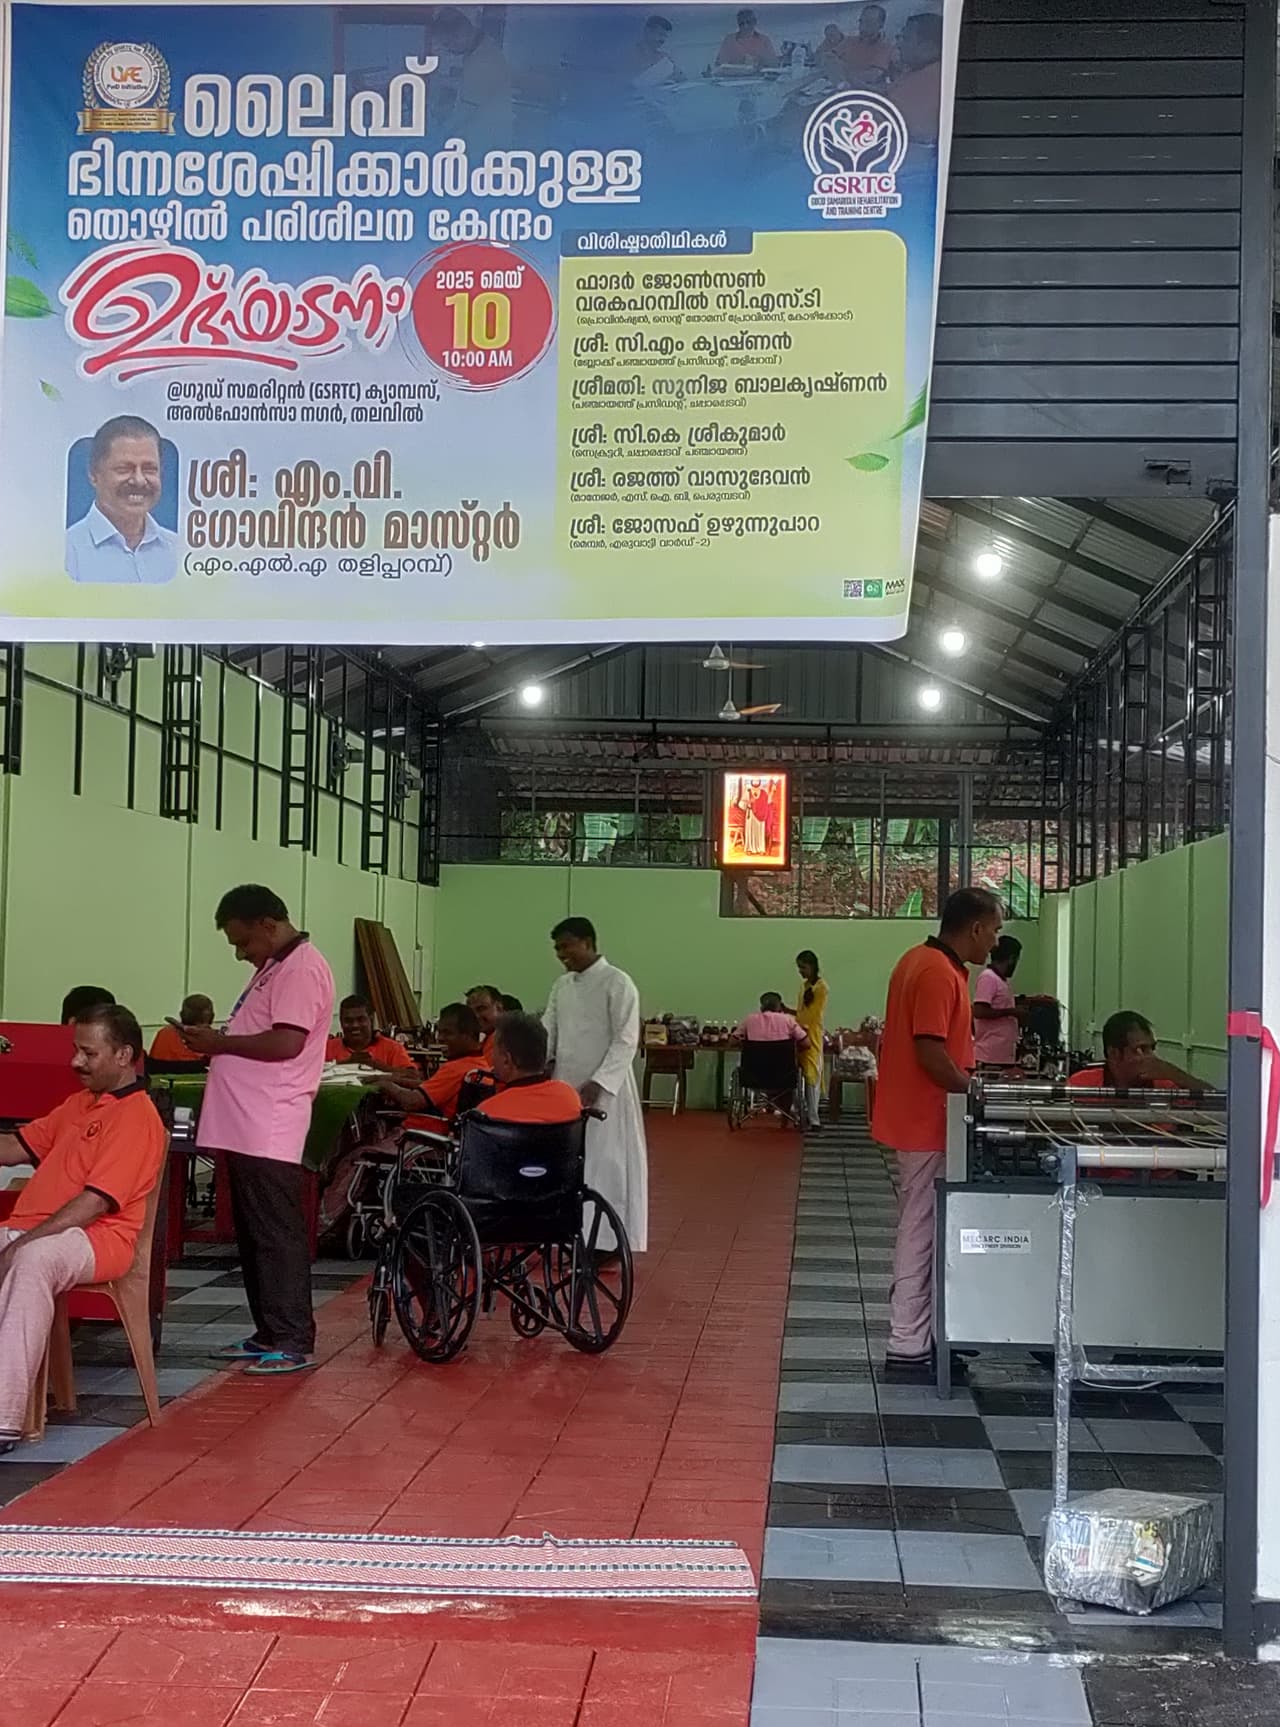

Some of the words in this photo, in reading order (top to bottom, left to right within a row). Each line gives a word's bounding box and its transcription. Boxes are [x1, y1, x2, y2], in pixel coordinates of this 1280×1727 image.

[184, 55, 439, 138] ലൈഫ്
[67, 137, 642, 209] ഭിന്നശേഷിക്കാർക്കുള്ള
[818, 176, 892, 193] GSRTC
[67, 200, 228, 243] തൊഴിൽ
[241, 200, 415, 243] പരിശീലന
[427, 207, 552, 247] കേന്ദ്രം
[436, 271, 473, 290] 2025
[480, 265, 526, 289] മെയ്
[576, 272, 635, 291] ഫാദർ
[642, 270, 766, 289] ജോൺസൺ
[716, 289, 821, 312] സി.എസ്.ടി
[446, 293, 510, 350] 10
[615, 333, 685, 355] സി.എം
[692, 331, 792, 357] കൃഷ്ണൻ
[442, 350, 484, 368] 10:00
[488, 350, 512, 367] AM
[309, 381, 361, 403] (GSRTC)
[652, 374, 728, 399] സുനിജ
[735, 372, 887, 398] ബാലകൃഷ്ണൻ
[350, 402, 424, 422] തലവിൽ
[613, 423, 681, 444] സി.കെ
[687, 422, 786, 447] ശ്രീകുമാർ
[187, 449, 257, 505] ശ്രീ:
[687, 468, 810, 490] വാസുദേവൻ
[187, 500, 366, 552] ഗോവിന്ദൻ
[384, 500, 521, 561] മാസ്റ്റർ
[612, 513, 703, 534] ജോസഫ്
[1004, 1235, 1029, 1243] INDIA
